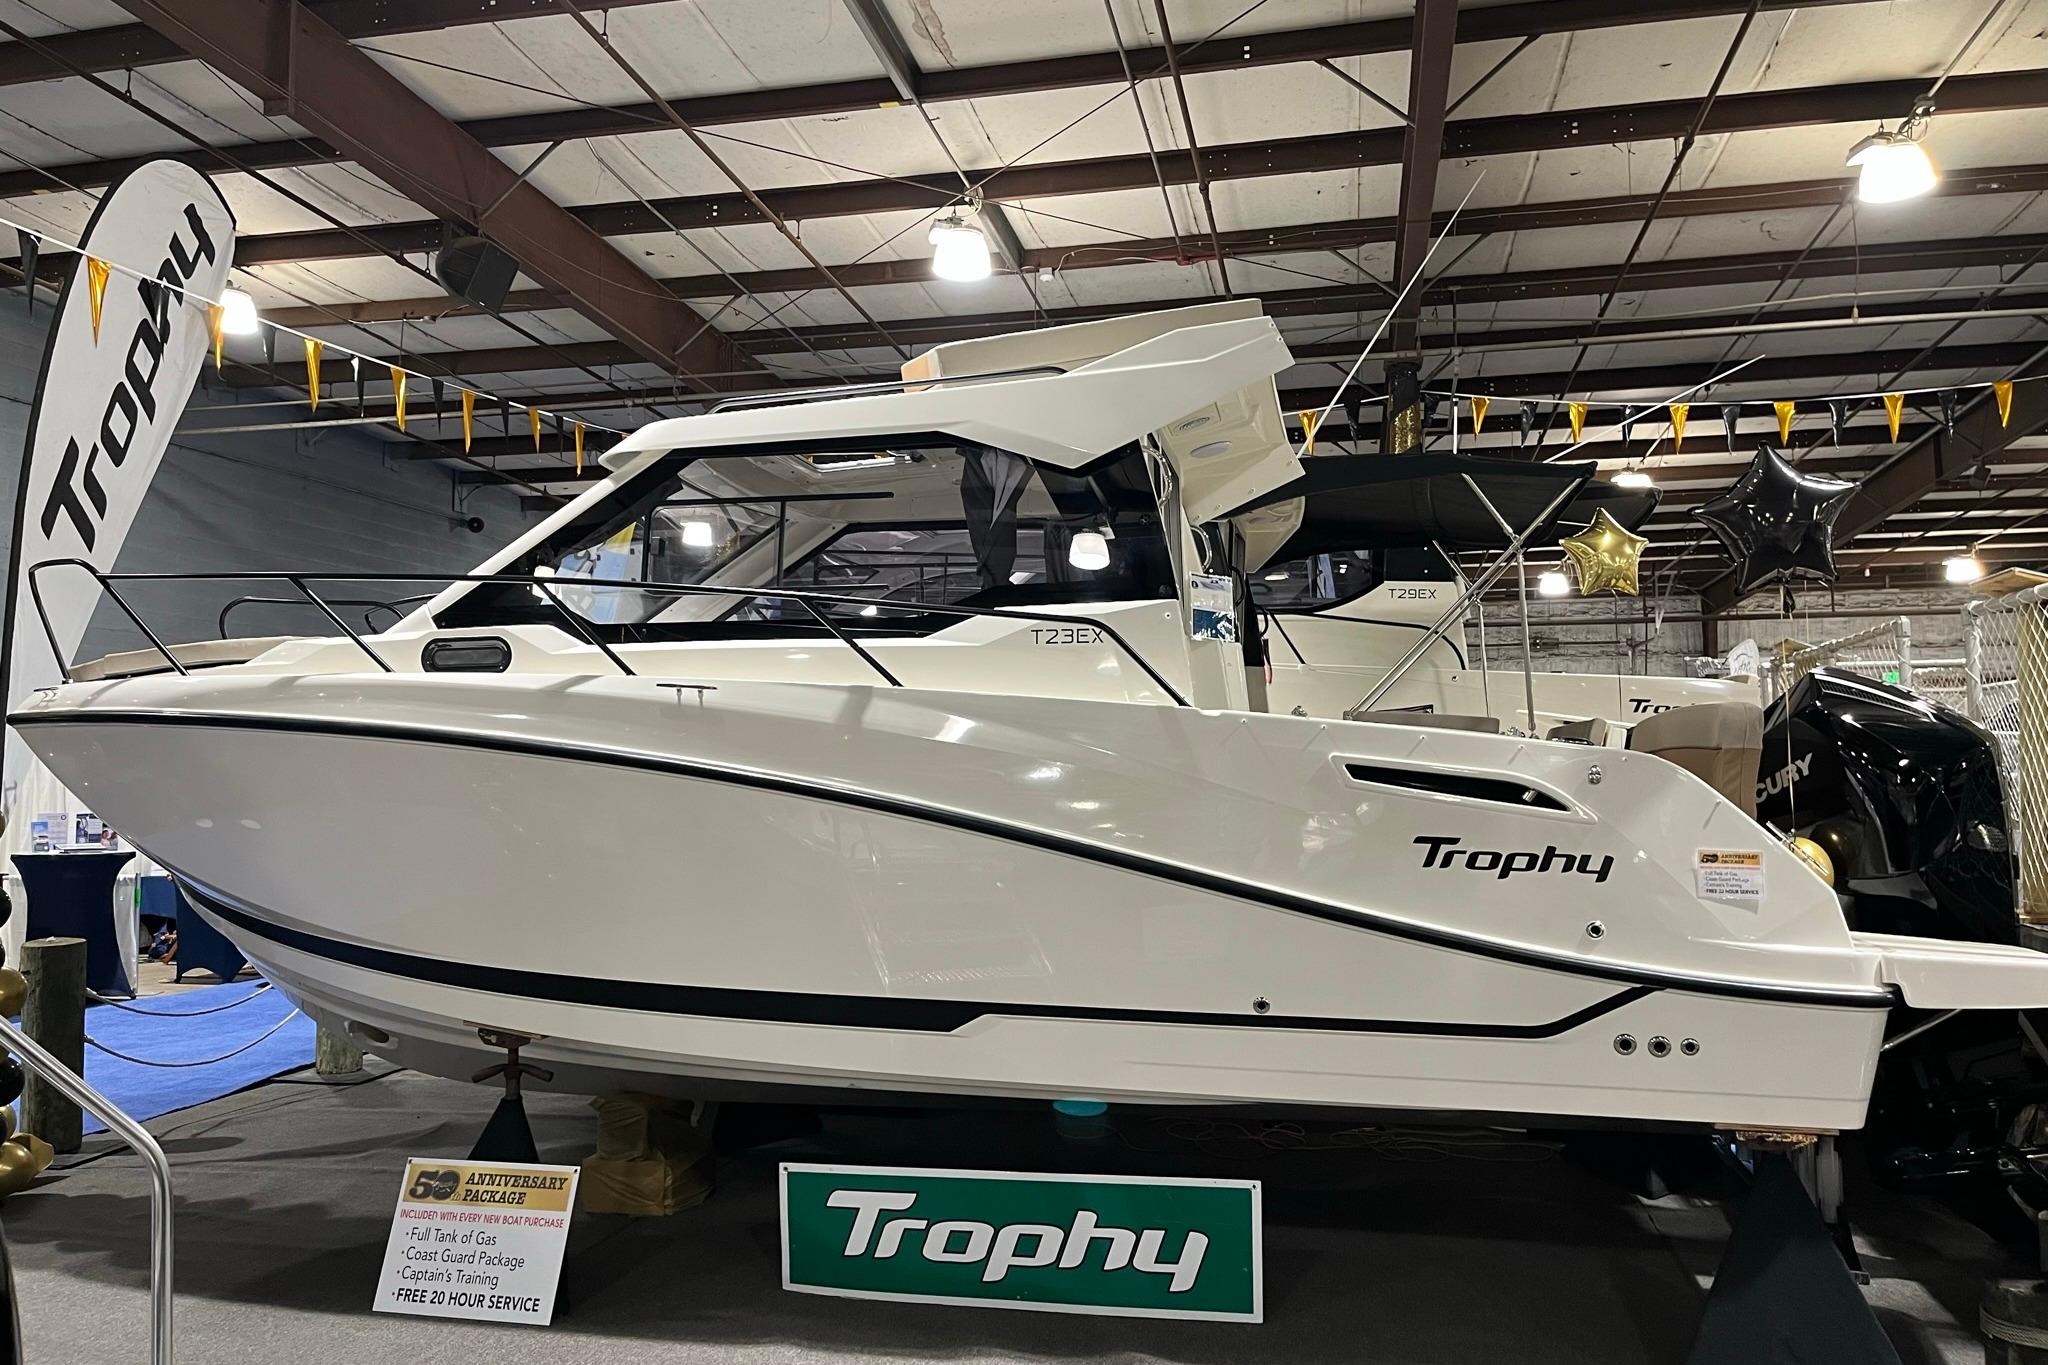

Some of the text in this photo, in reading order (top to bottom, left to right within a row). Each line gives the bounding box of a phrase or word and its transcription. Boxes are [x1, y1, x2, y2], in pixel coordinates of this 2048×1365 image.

[41, 203, 216, 553] Trophy
[1388, 588, 1437, 599] T29EX
[1031, 628, 1104, 645] T23EX
[1629, 698, 1681, 713] Tro
[1413, 836, 1615, 883] Trophy
[465, 1173, 568, 1190] ANNIVERSARY
[462, 1189, 526, 1205] PACKAGE
[400, 1208, 565, 1228] INCLUDED WITH EVERY NEW BOAT PURCHASE
[410, 1227, 497, 1246] Full Tank of Gas
[826, 1189, 1209, 1292] Trophy
[406, 1246, 525, 1271] Coast Guard Package
[401, 1265, 499, 1290] Captain's Training
[396, 1287, 541, 1312] FREE 20 HOUR SERVICE
